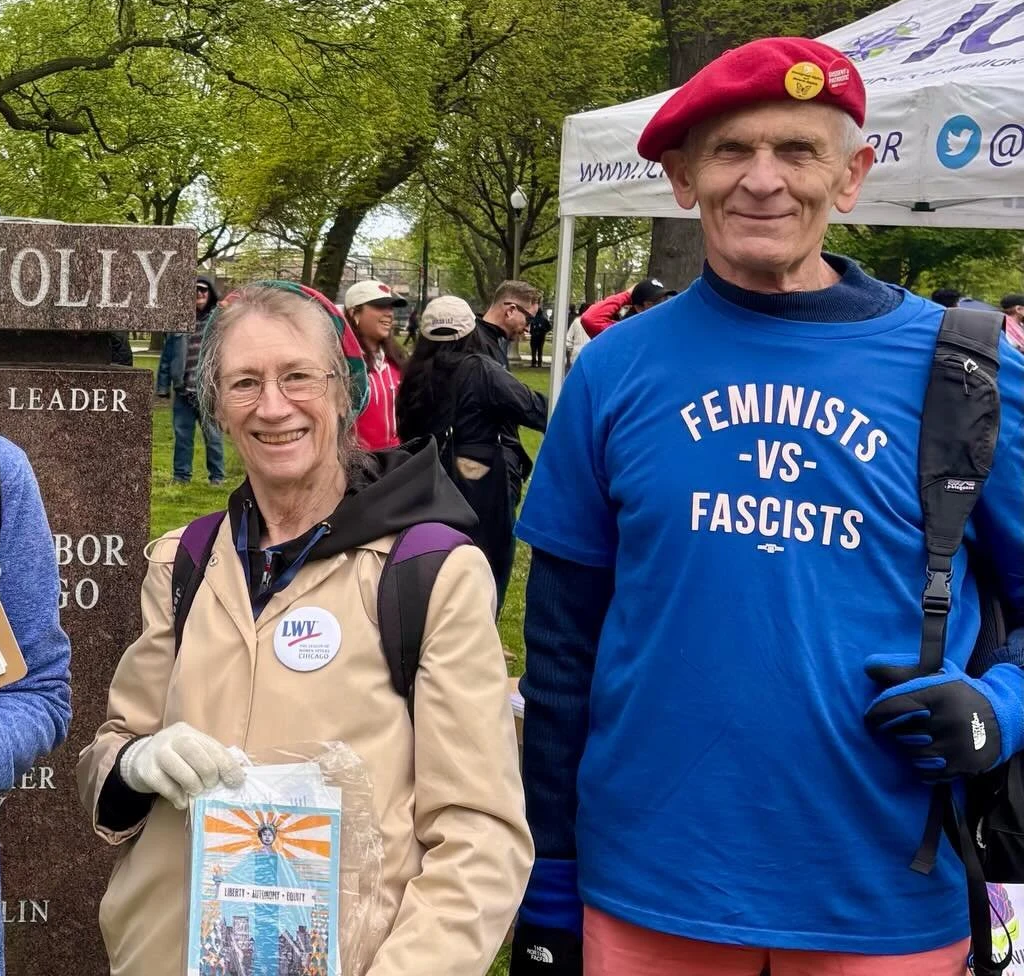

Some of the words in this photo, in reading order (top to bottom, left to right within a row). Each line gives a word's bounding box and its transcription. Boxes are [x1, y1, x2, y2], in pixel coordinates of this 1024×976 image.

[8, 387, 131, 412] LEADER
[680, 383, 888, 462] FEMINISTS
[691, 492, 864, 550] FASCISTS
[53, 534, 128, 566] BOR
[281, 620, 316, 637] LWV
[12, 766, 56, 789] ER
[224, 887, 245, 899] LIBERTY
[286, 891, 305, 903] EQUITY
[1, 899, 50, 923] LIN
